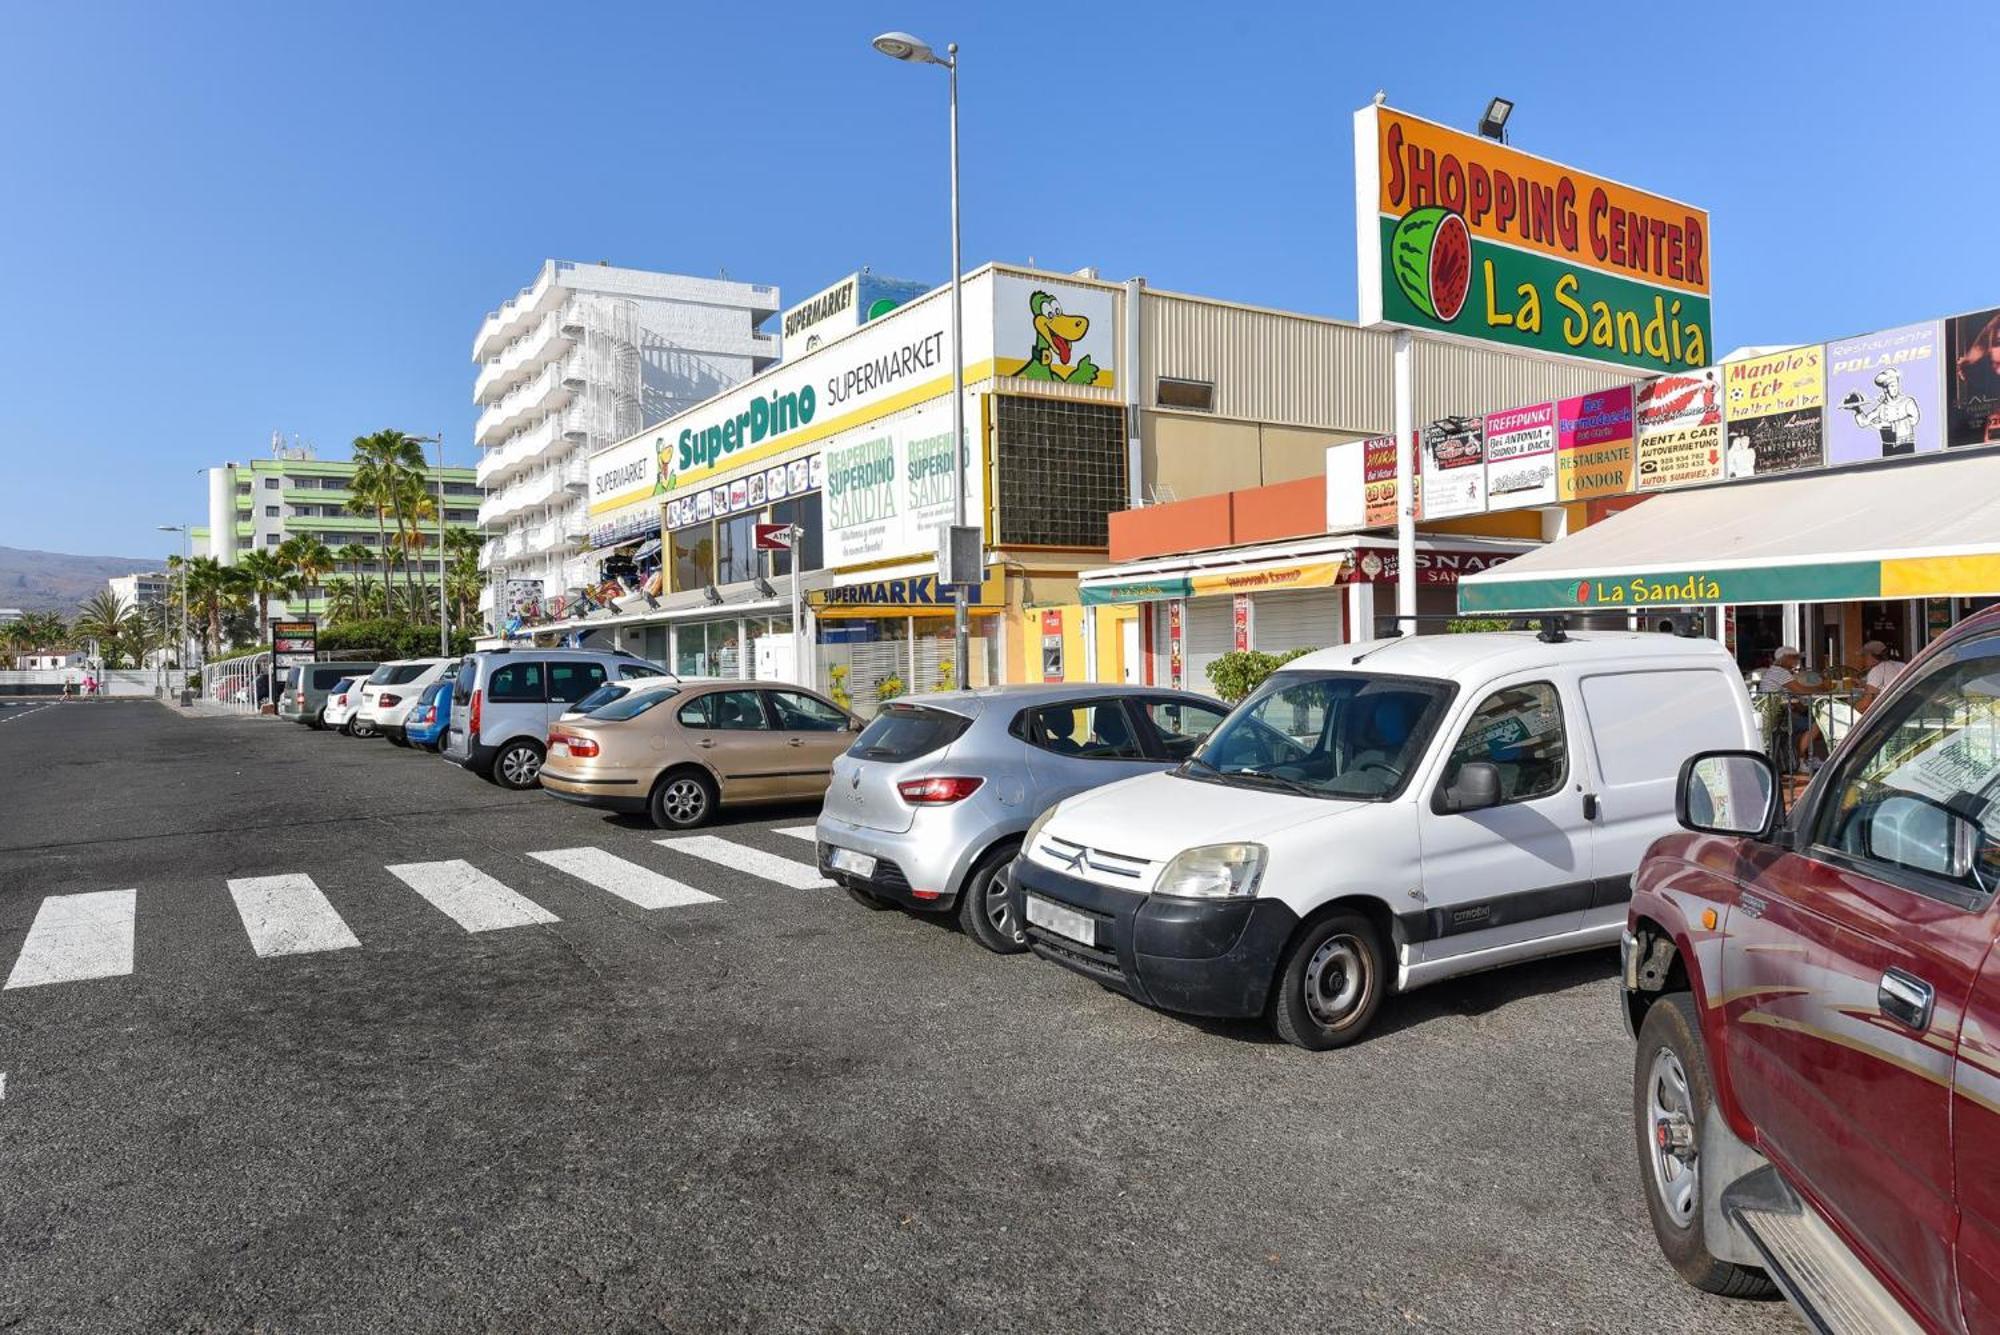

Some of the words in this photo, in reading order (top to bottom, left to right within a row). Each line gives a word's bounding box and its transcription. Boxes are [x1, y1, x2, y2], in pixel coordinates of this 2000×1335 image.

[1387, 122, 1578, 252] SHOPPING
[1589, 187, 1703, 285] CENTER
[785, 281, 853, 339] SUPERMARKET
[1483, 260, 1541, 333] La
[1554, 273, 1705, 367] Sandía
[827, 331, 944, 406] SUPERMARKET
[1730, 352, 1817, 382] Manolo's
[1833, 345, 1932, 375] POLARIS
[679, 385, 816, 470] SuperDino
[1488, 408, 1551, 431] TREFFPUNKT
[1505, 429, 1542, 444] ANTONIA
[1641, 434, 1675, 447] RENT
[1677, 432, 1686, 441] A
[1690, 427, 1718, 439] CAR
[1642, 439, 1718, 457] AUTOVERMIETUNG
[827, 435, 893, 473] REAPERTURA
[908, 447, 970, 481] SUPERDIO
[1560, 447, 1630, 469] RESTAURANTE
[596, 458, 647, 495] SUPERMARKET
[828, 456, 895, 497] SUPERDINO
[1568, 471, 1623, 491] CONDOR
[1642, 475, 1665, 484] AUTOS
[773, 533, 790, 541] ATM
[1597, 582, 1624, 602] La
[1631, 575, 1720, 602] Sandía
